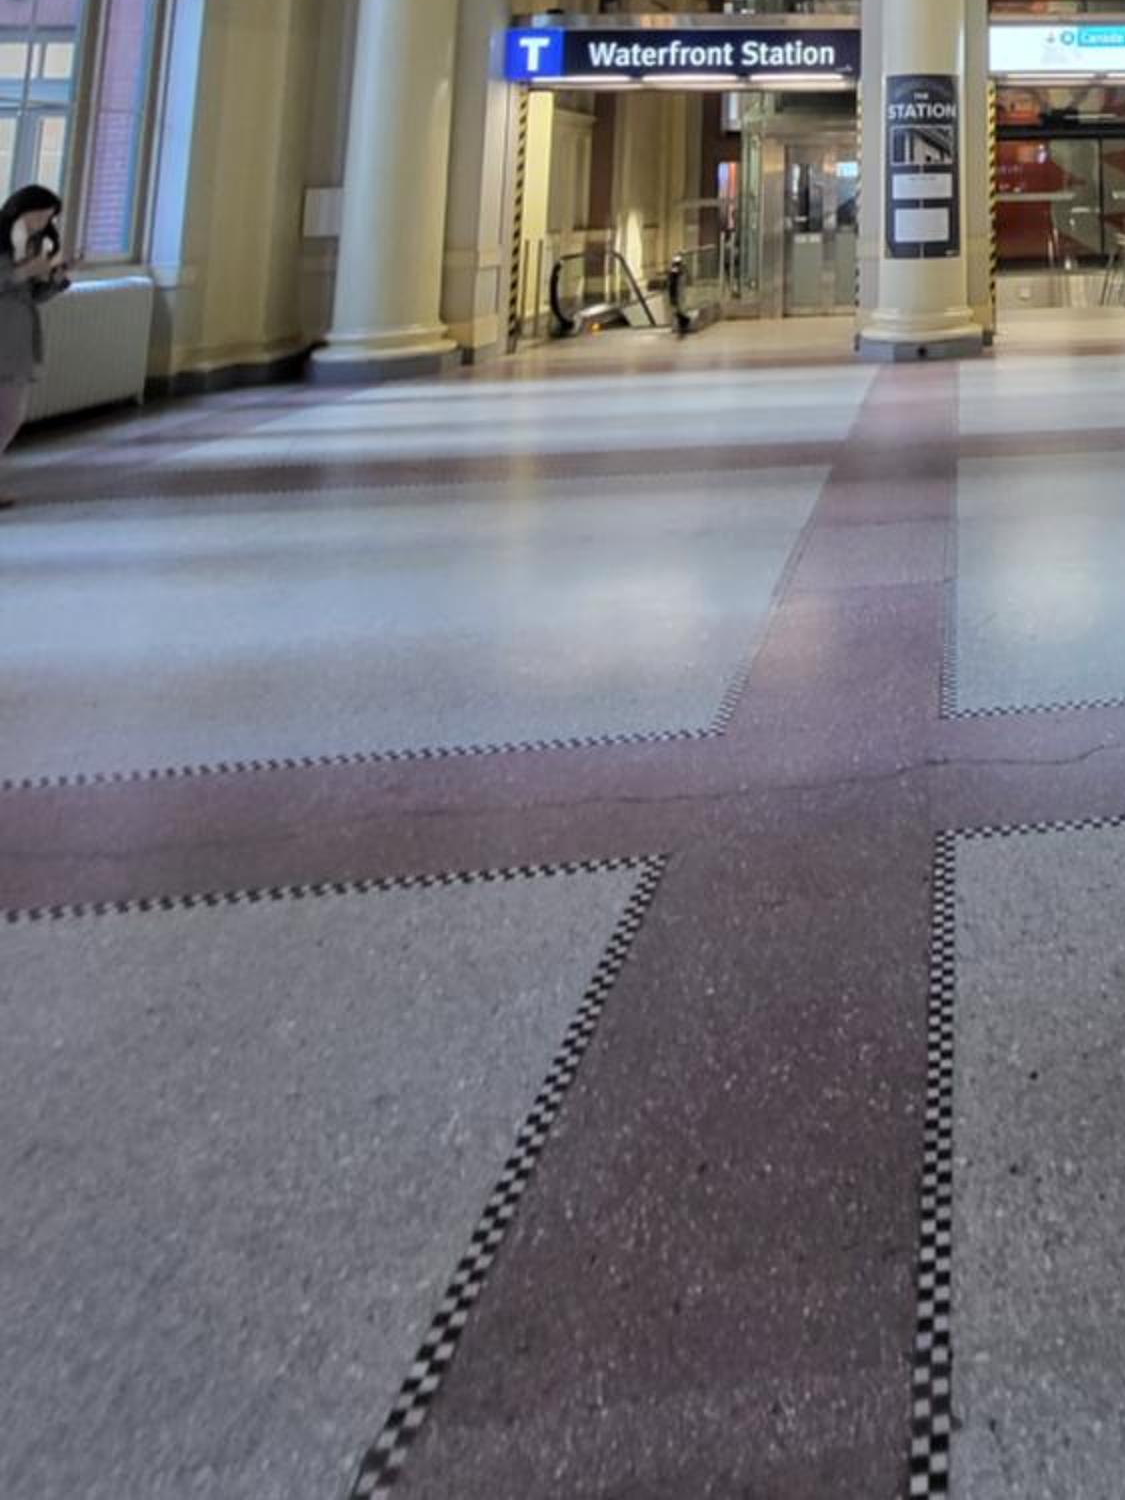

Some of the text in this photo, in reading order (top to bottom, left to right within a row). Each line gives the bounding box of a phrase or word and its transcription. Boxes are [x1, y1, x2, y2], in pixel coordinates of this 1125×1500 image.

[1079, 32, 1122, 45] Canada
[519, 37, 551, 71] T
[588, 40, 835, 67] Waterfront Station
[887, 102, 957, 120] STATION
